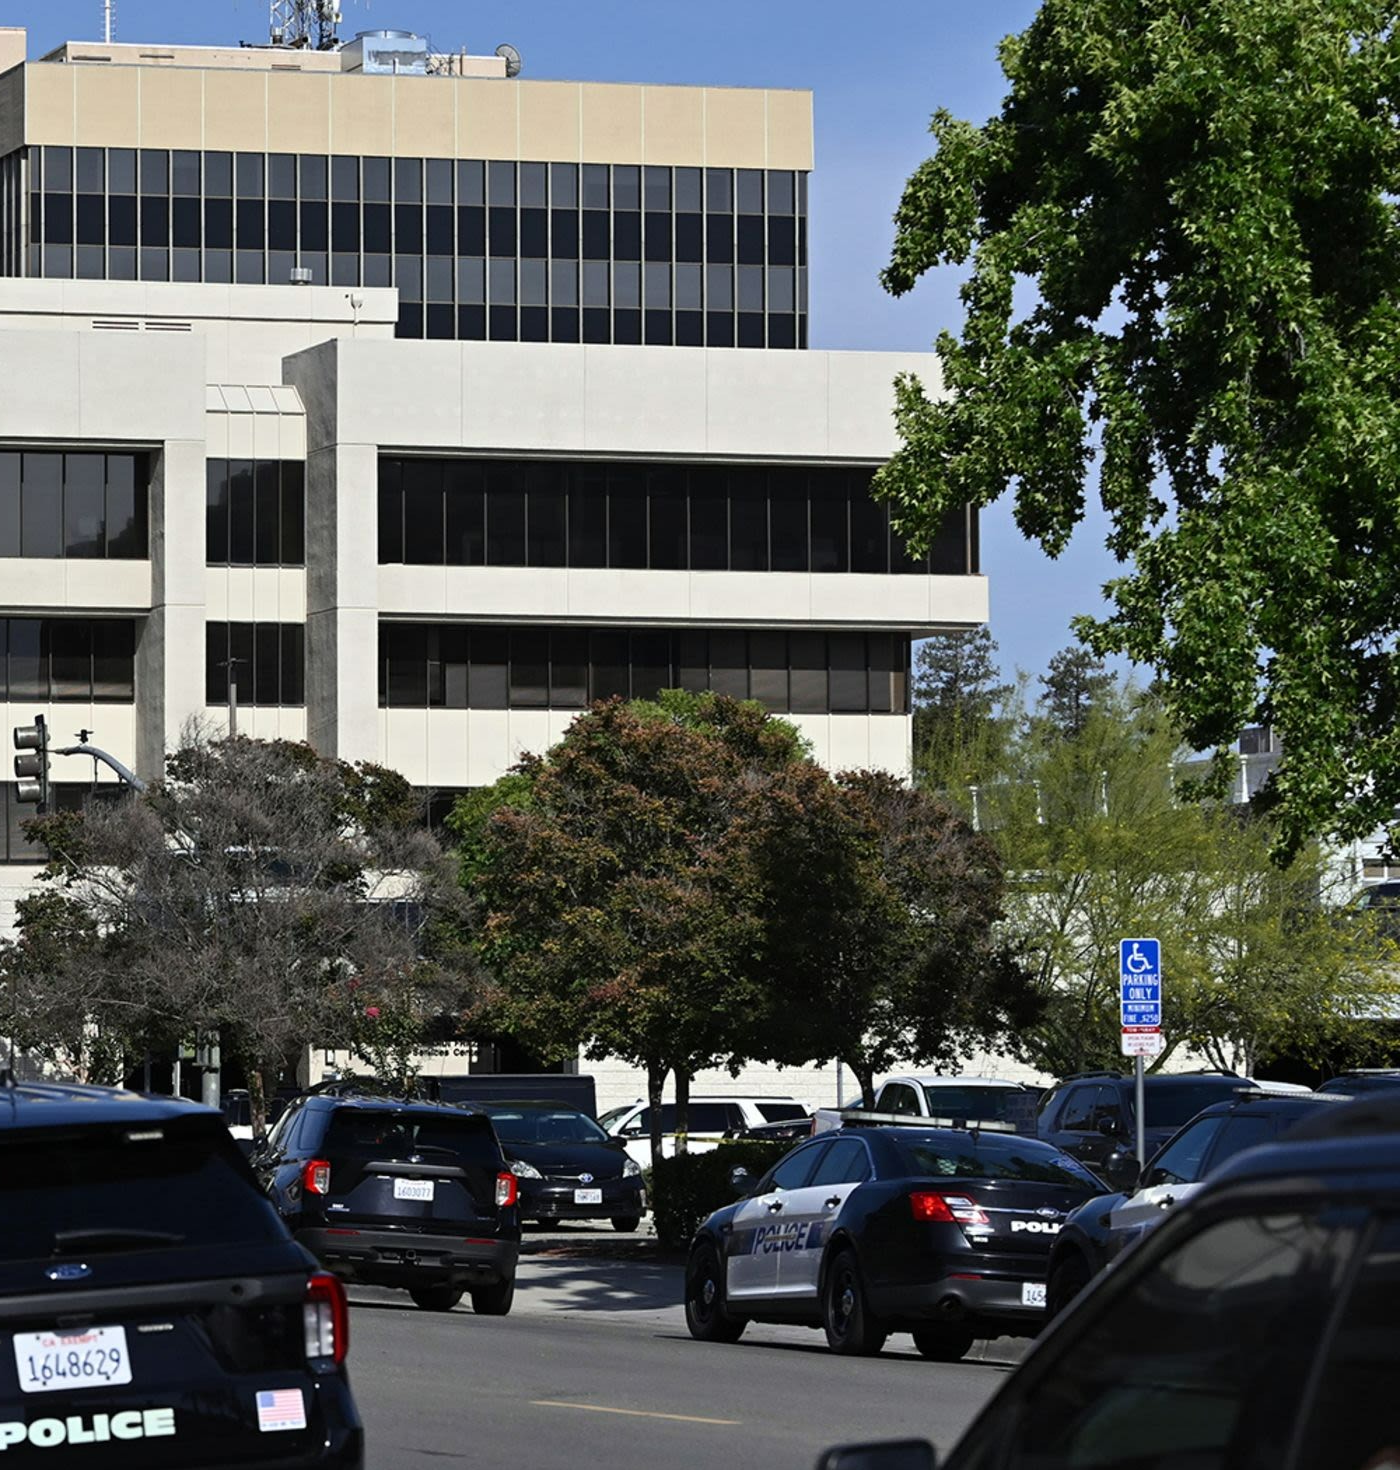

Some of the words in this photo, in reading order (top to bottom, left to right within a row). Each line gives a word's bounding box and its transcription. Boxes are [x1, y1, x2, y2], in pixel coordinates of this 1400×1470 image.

[1122, 974, 1159, 986] PARKING
[1129, 987, 1153, 999] ONLY
[1123, 1013, 1137, 1023] FINE
[754, 1222, 809, 1255] POLICE
[28, 1347, 122, 1382] 1648629
